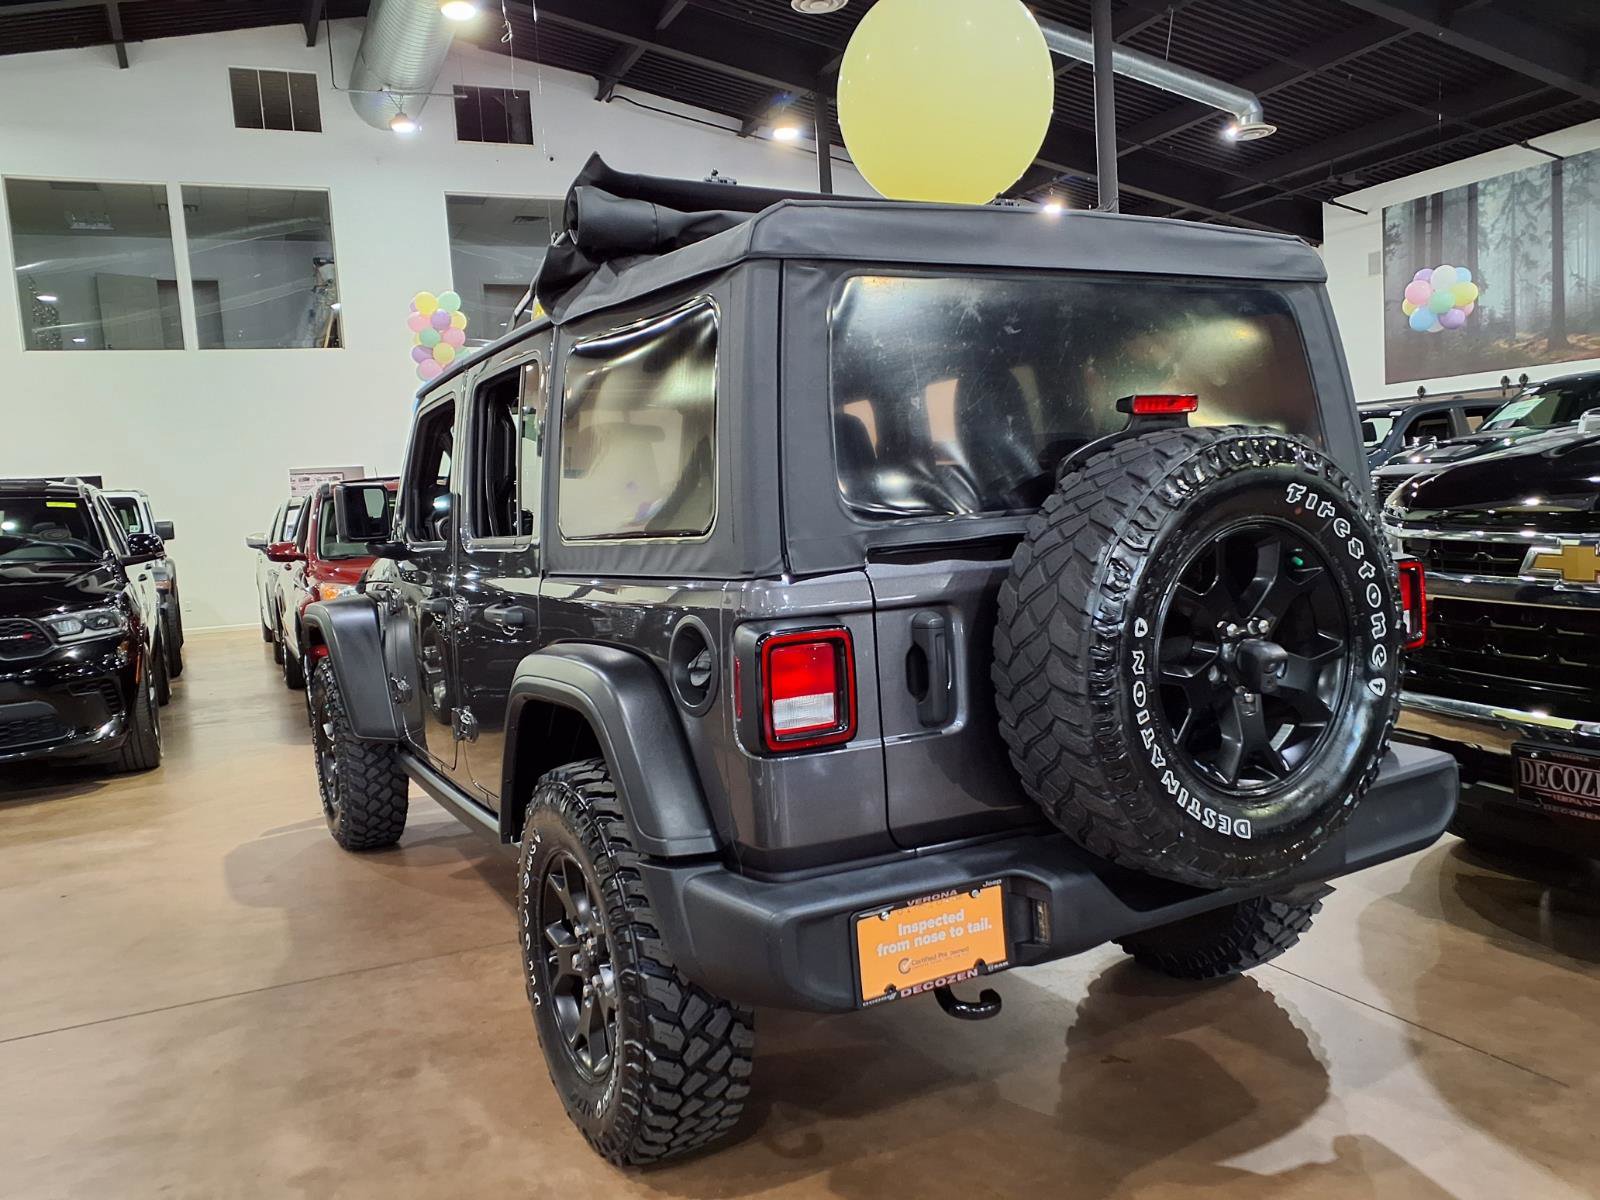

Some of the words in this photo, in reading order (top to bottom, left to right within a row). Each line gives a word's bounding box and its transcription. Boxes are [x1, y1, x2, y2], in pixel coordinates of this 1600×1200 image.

[1286, 483, 1387, 668] Firestone
[1132, 650, 1252, 839] DESTINATION
[906, 889, 958, 906] VERONA
[982, 879, 1002, 888] Jeep
[876, 938, 910, 957] from
[913, 930, 946, 947] nose
[950, 925, 964, 938] to
[967, 917, 993, 934] tail.
[898, 909, 965, 936] Inspected
[900, 968, 979, 998] DECOZEN
